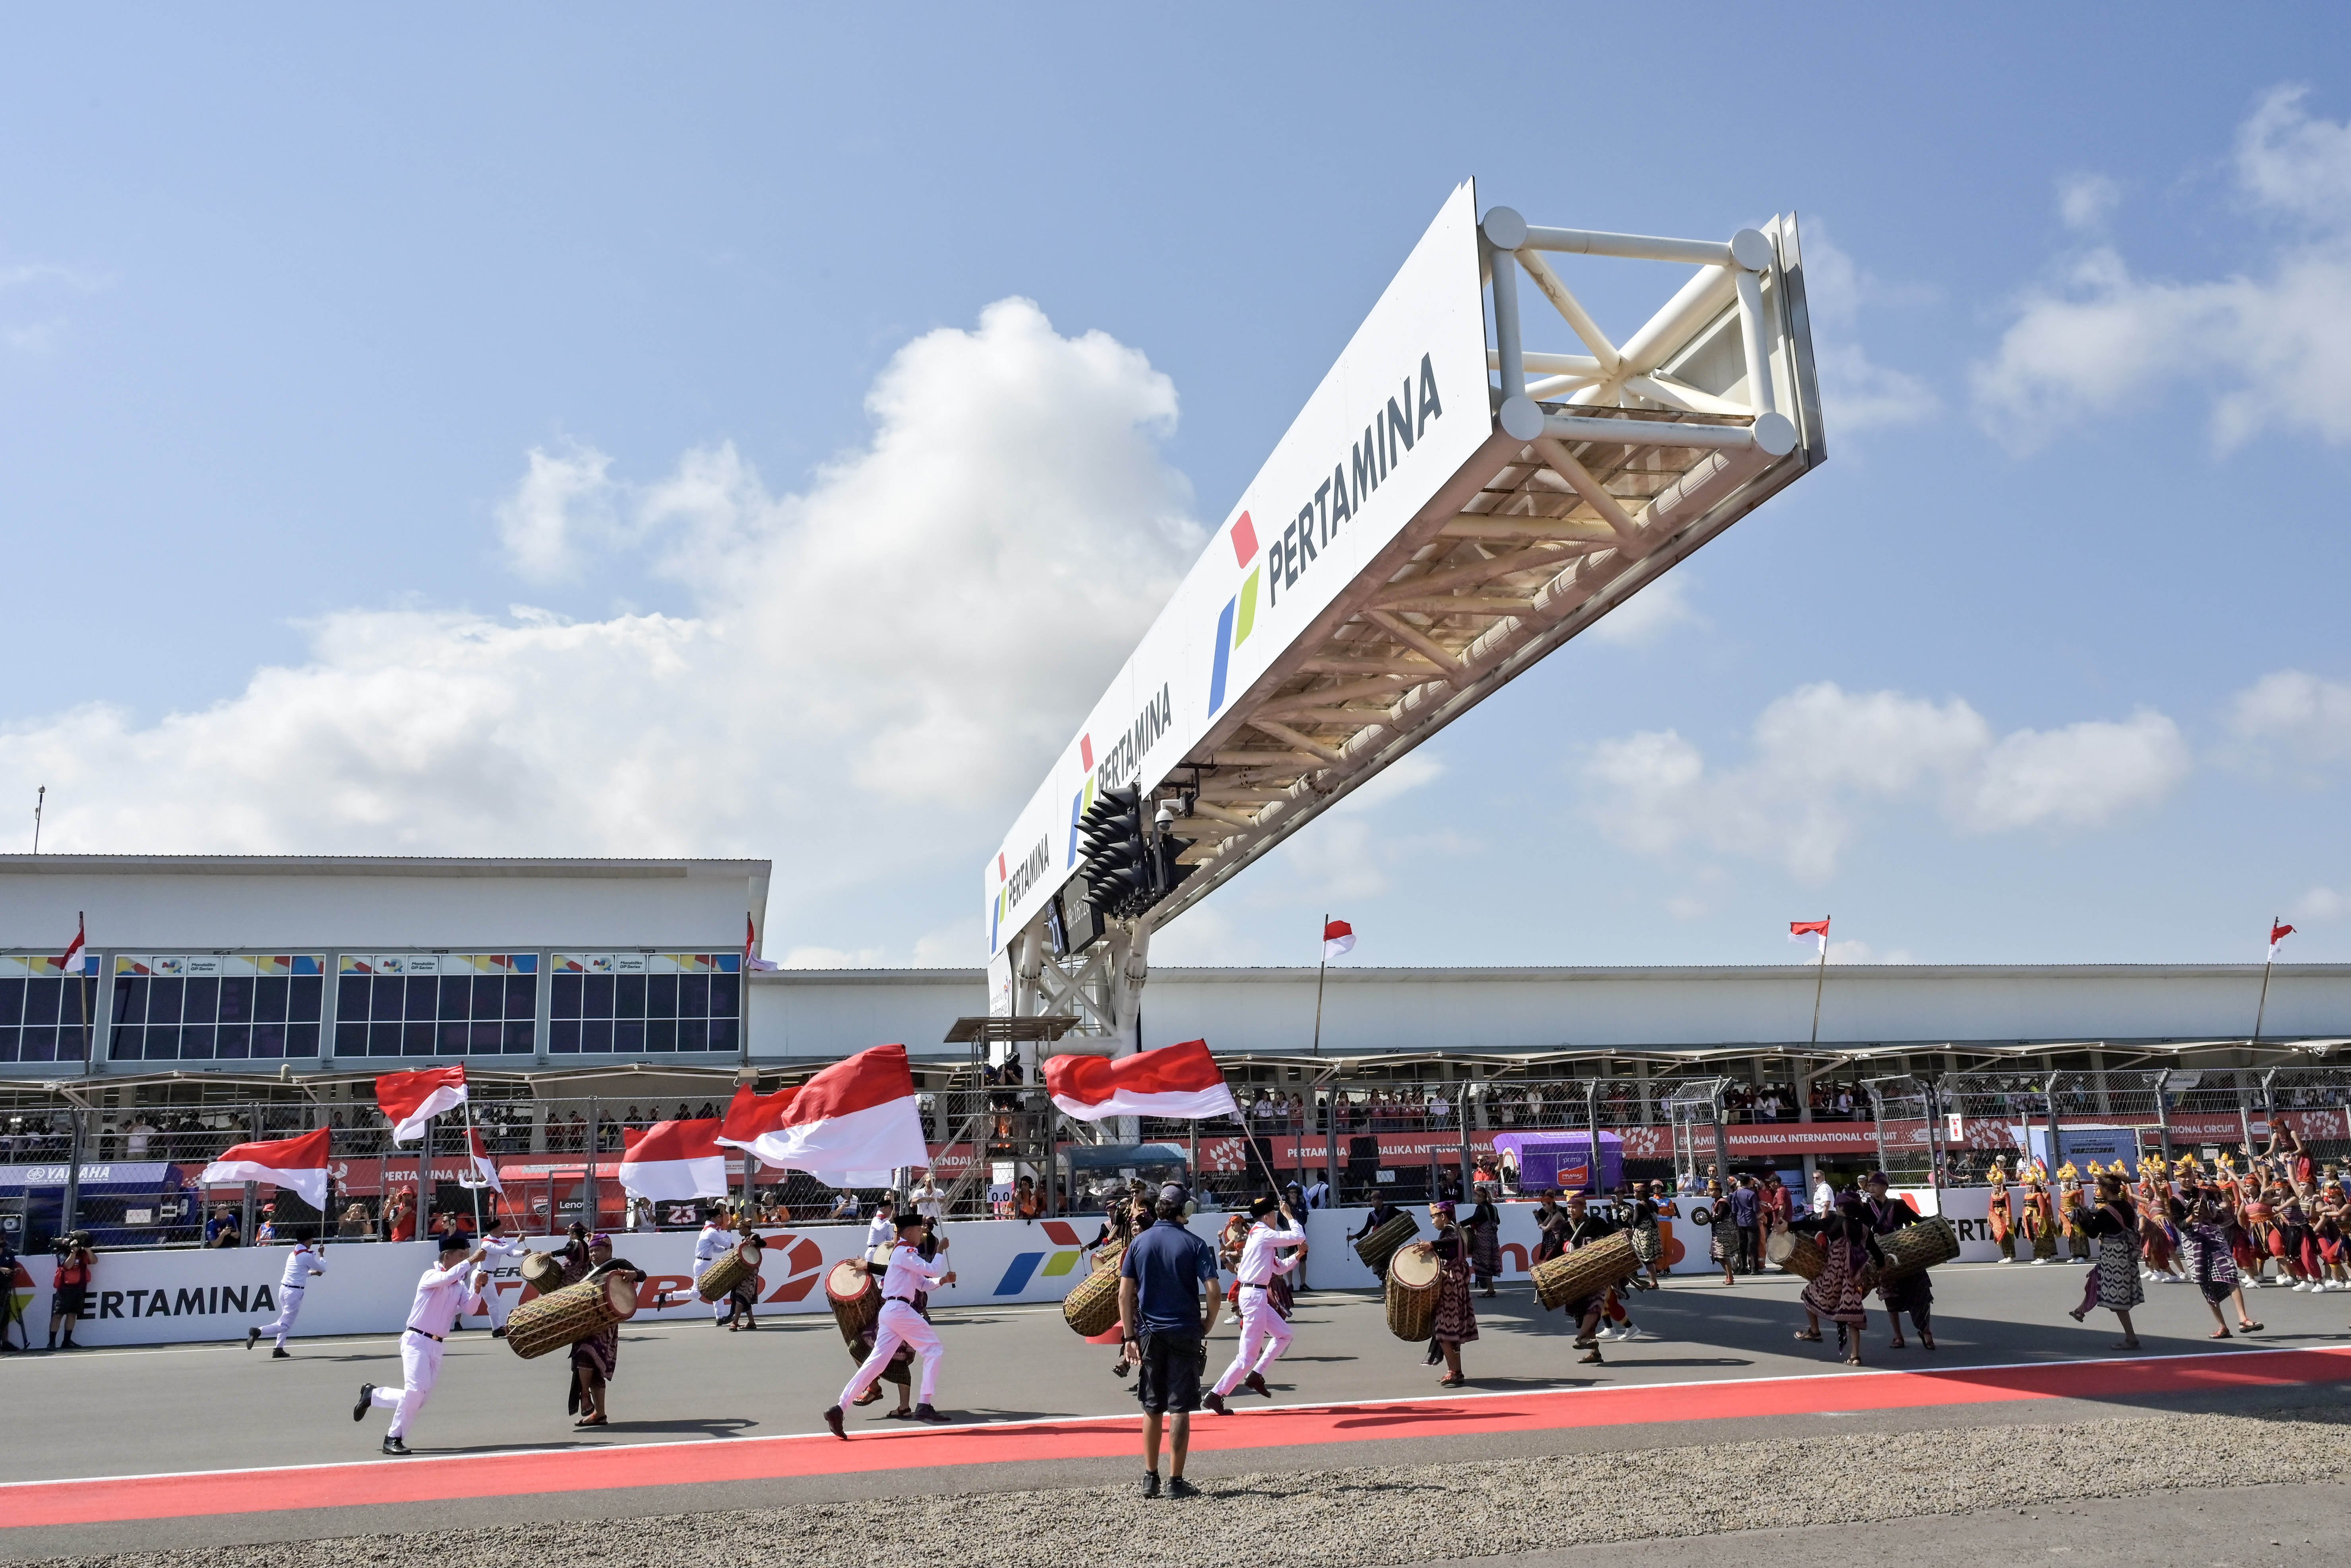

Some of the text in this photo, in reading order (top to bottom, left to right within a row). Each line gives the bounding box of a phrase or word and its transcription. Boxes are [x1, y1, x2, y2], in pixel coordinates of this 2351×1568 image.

[1269, 351, 1442, 608] PERTAMINA
[1098, 682, 1171, 799] PERTAMINA
[1008, 833, 1049, 912] PERTAMINA
[1048, 915, 1061, 954] 27
[1729, 1134, 1786, 1144] MANDALIKA
[1788, 1132, 1861, 1143] INTERNATIONAL
[1863, 1132, 1897, 1141] CIRUIT
[1287, 1147, 1347, 1158] PERTAMA
[48, 1166, 110, 1179] YAAHA
[381, 1169, 454, 1181] PERTAINA
[992, 1192, 1009, 1202] 0.0
[668, 1204, 696, 1224] 23
[52, 1284, 276, 1320] ERTAMINA
